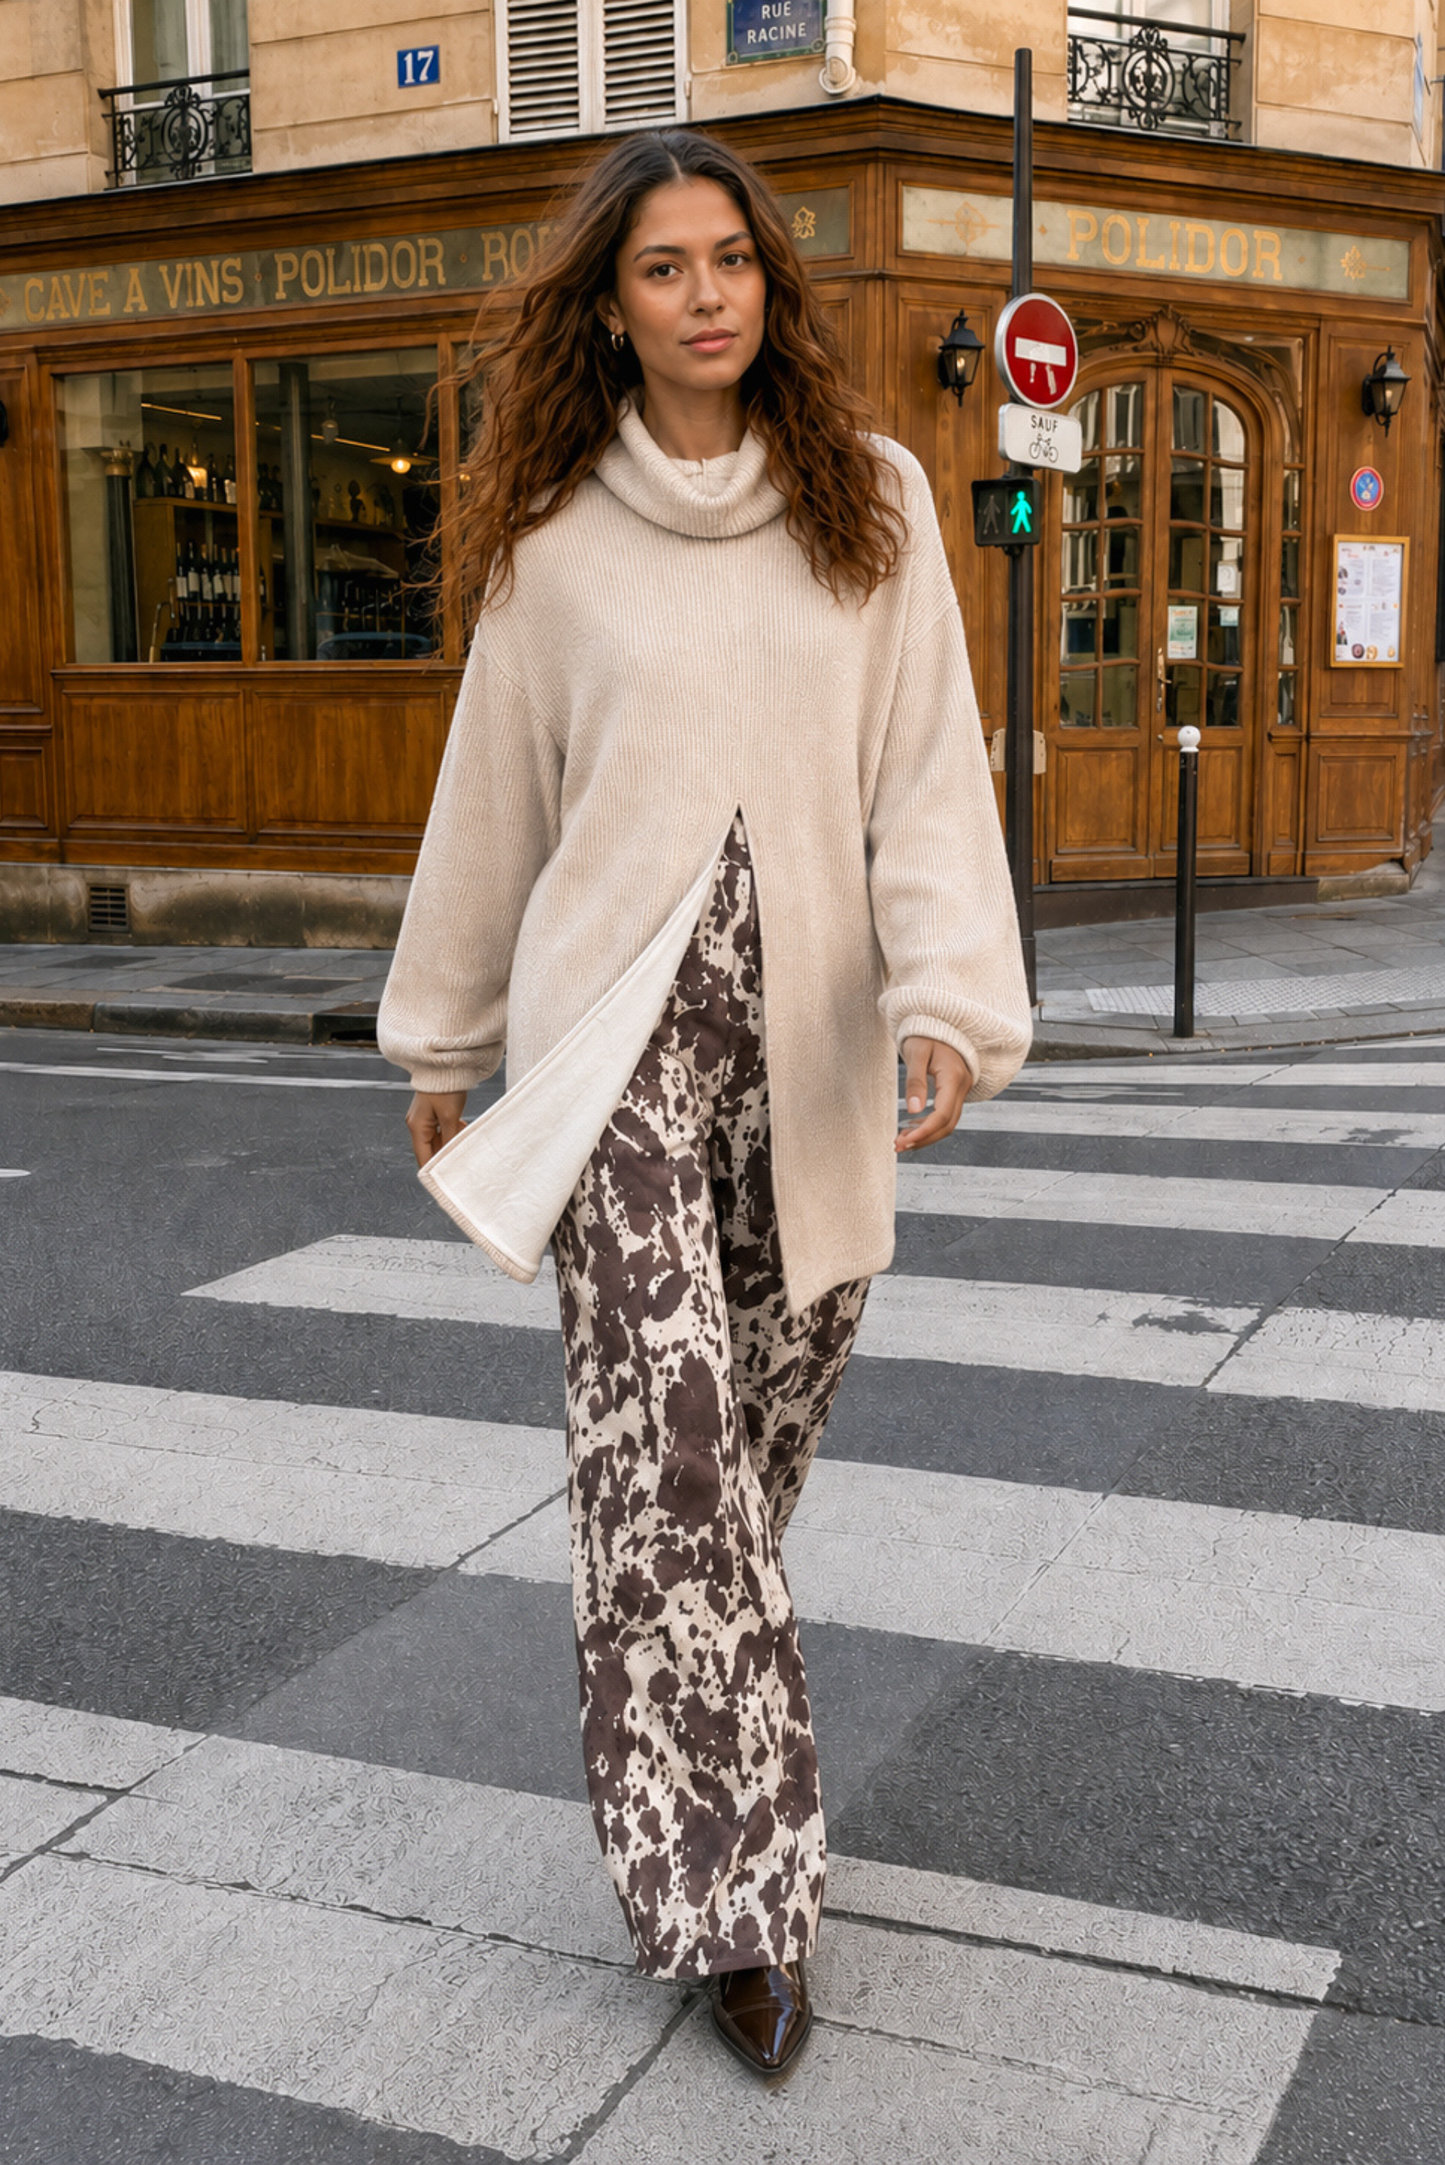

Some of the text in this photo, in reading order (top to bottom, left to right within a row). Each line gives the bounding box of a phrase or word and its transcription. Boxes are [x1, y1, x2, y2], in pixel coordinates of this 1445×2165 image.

[761, 1, 792, 20] RUE
[747, 22, 807, 45] RACINE
[403, 50, 434, 84] 17
[1066, 209, 1283, 281] POLIDOR
[24, 271, 111, 323] CAVE
[123, 267, 148, 312] A
[159, 257, 244, 309] VINS
[274, 237, 446, 300] POLIDOR
[1030, 414, 1059, 433] SAUF
